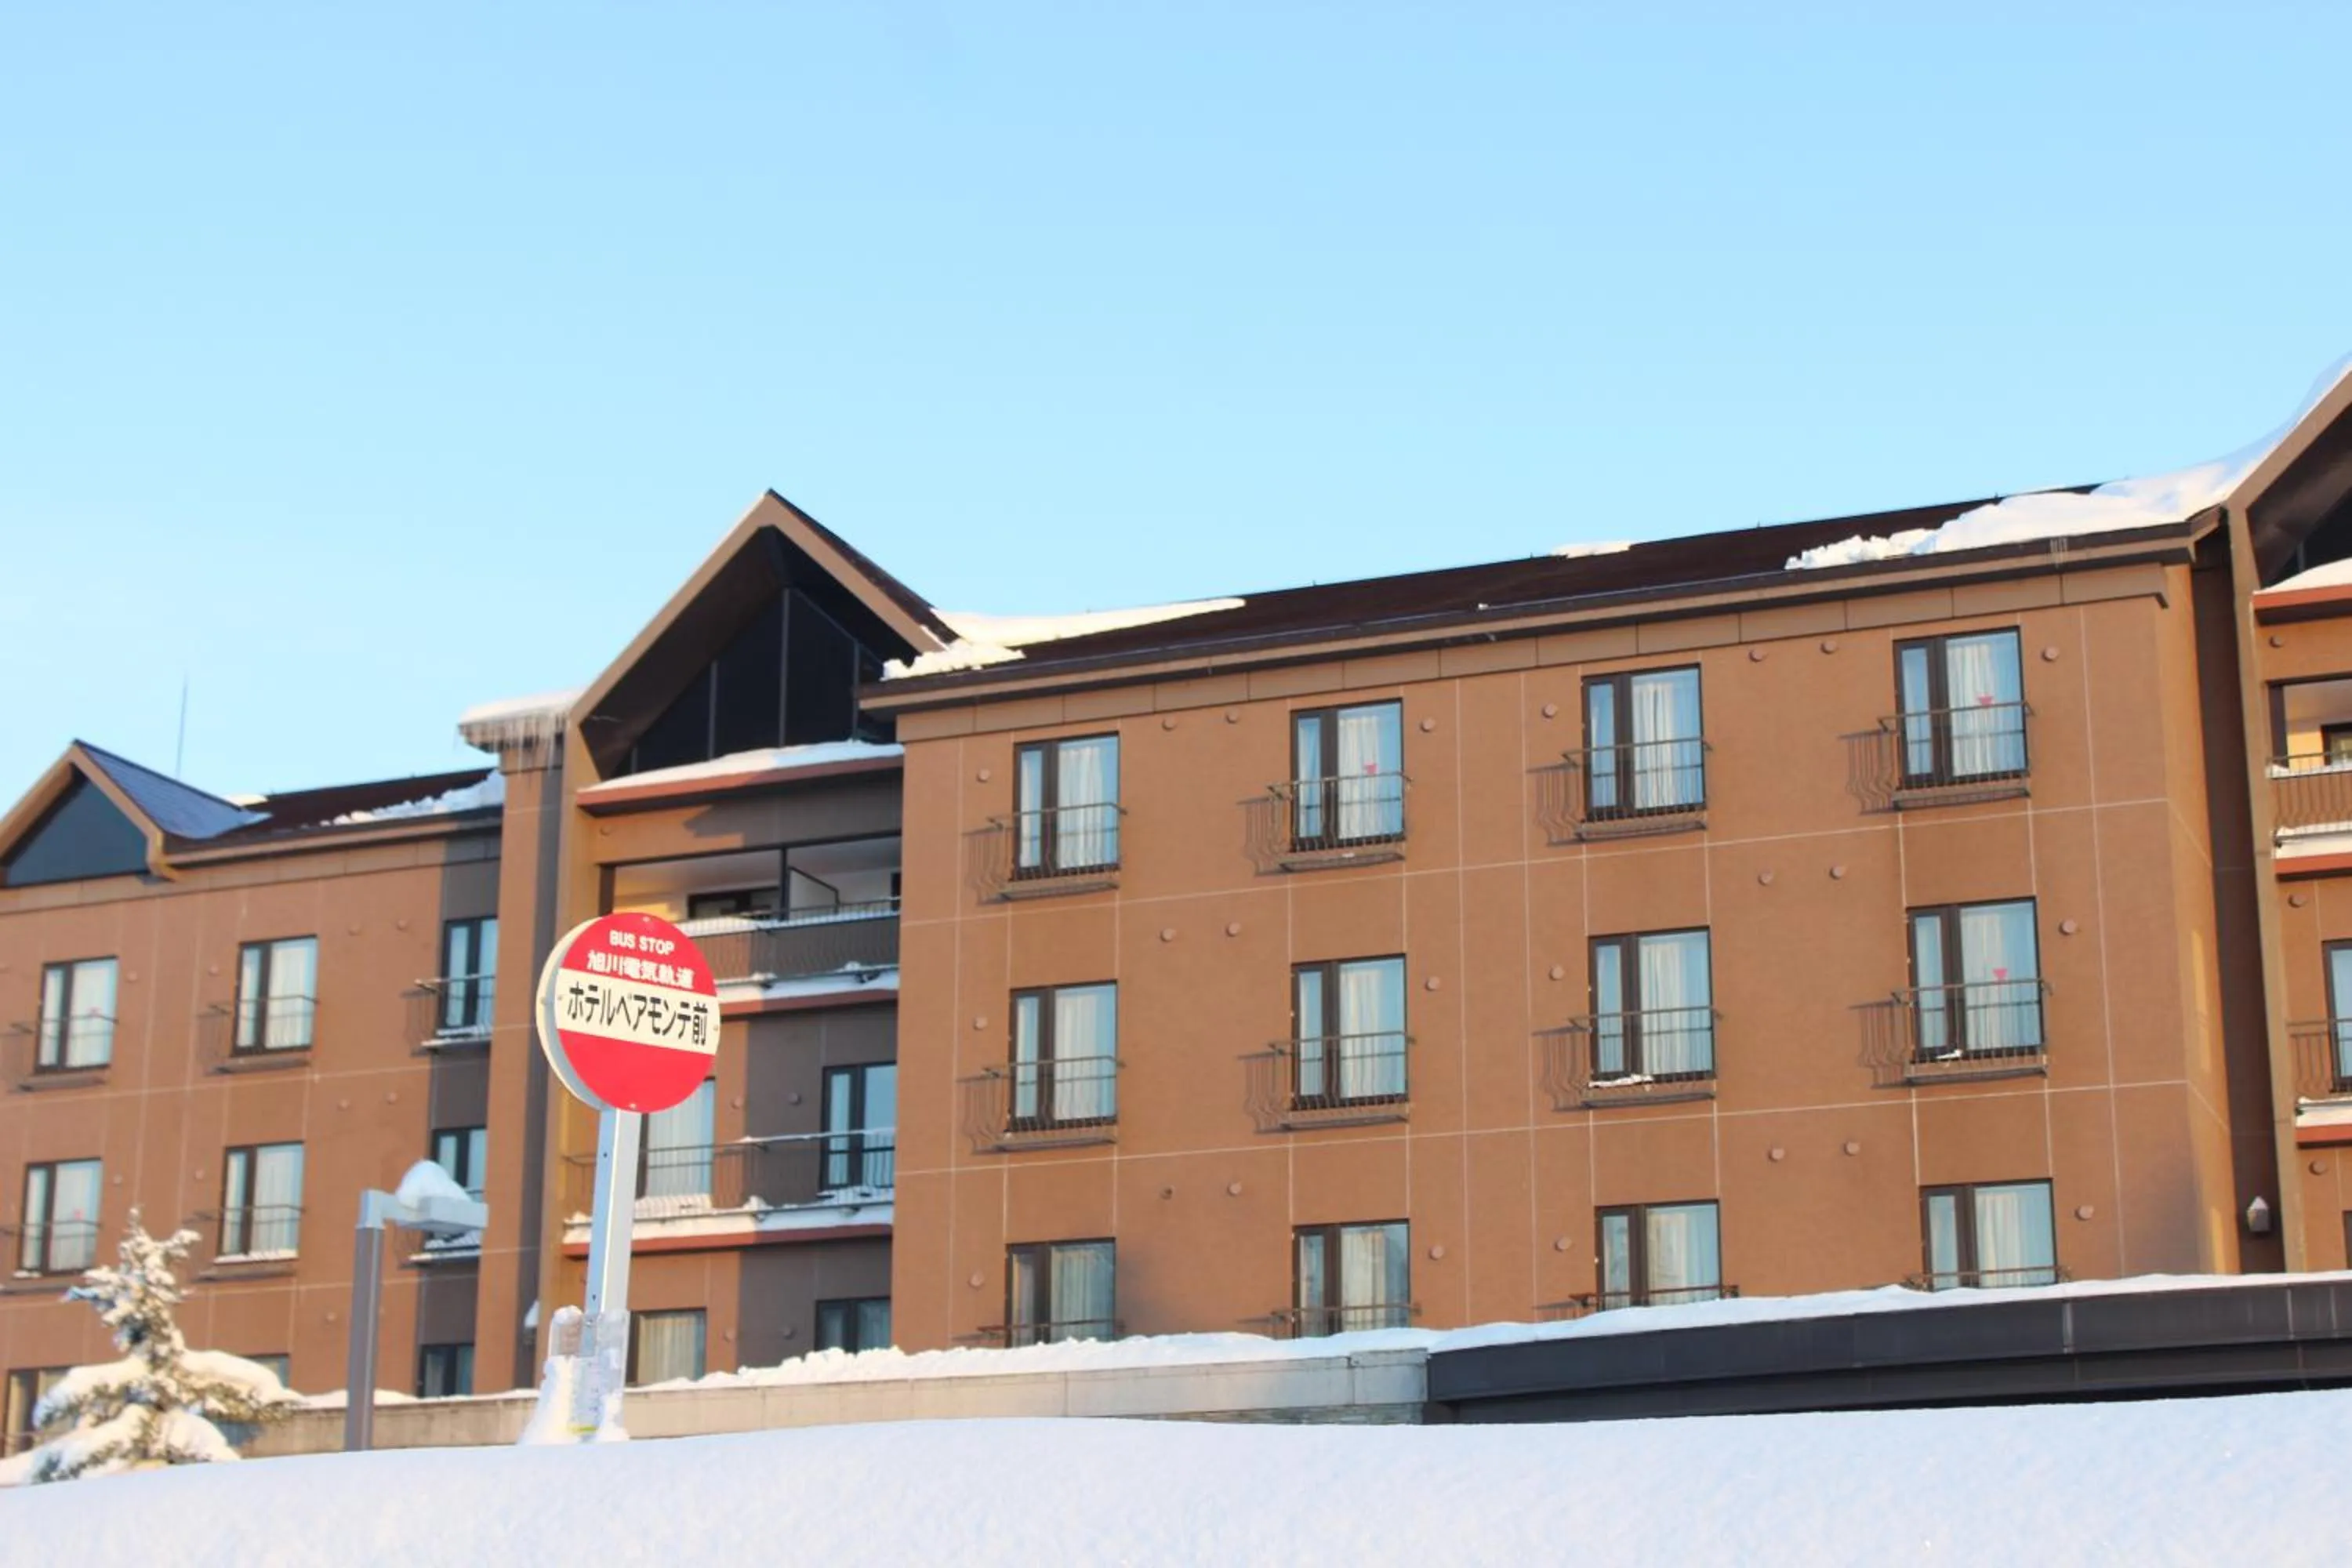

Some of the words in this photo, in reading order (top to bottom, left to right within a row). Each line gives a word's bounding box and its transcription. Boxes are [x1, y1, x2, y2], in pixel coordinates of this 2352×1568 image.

[609, 930, 636, 949] BUS
[639, 935, 675, 956] STOP
[587, 949, 695, 989] 旭川電気軌道
